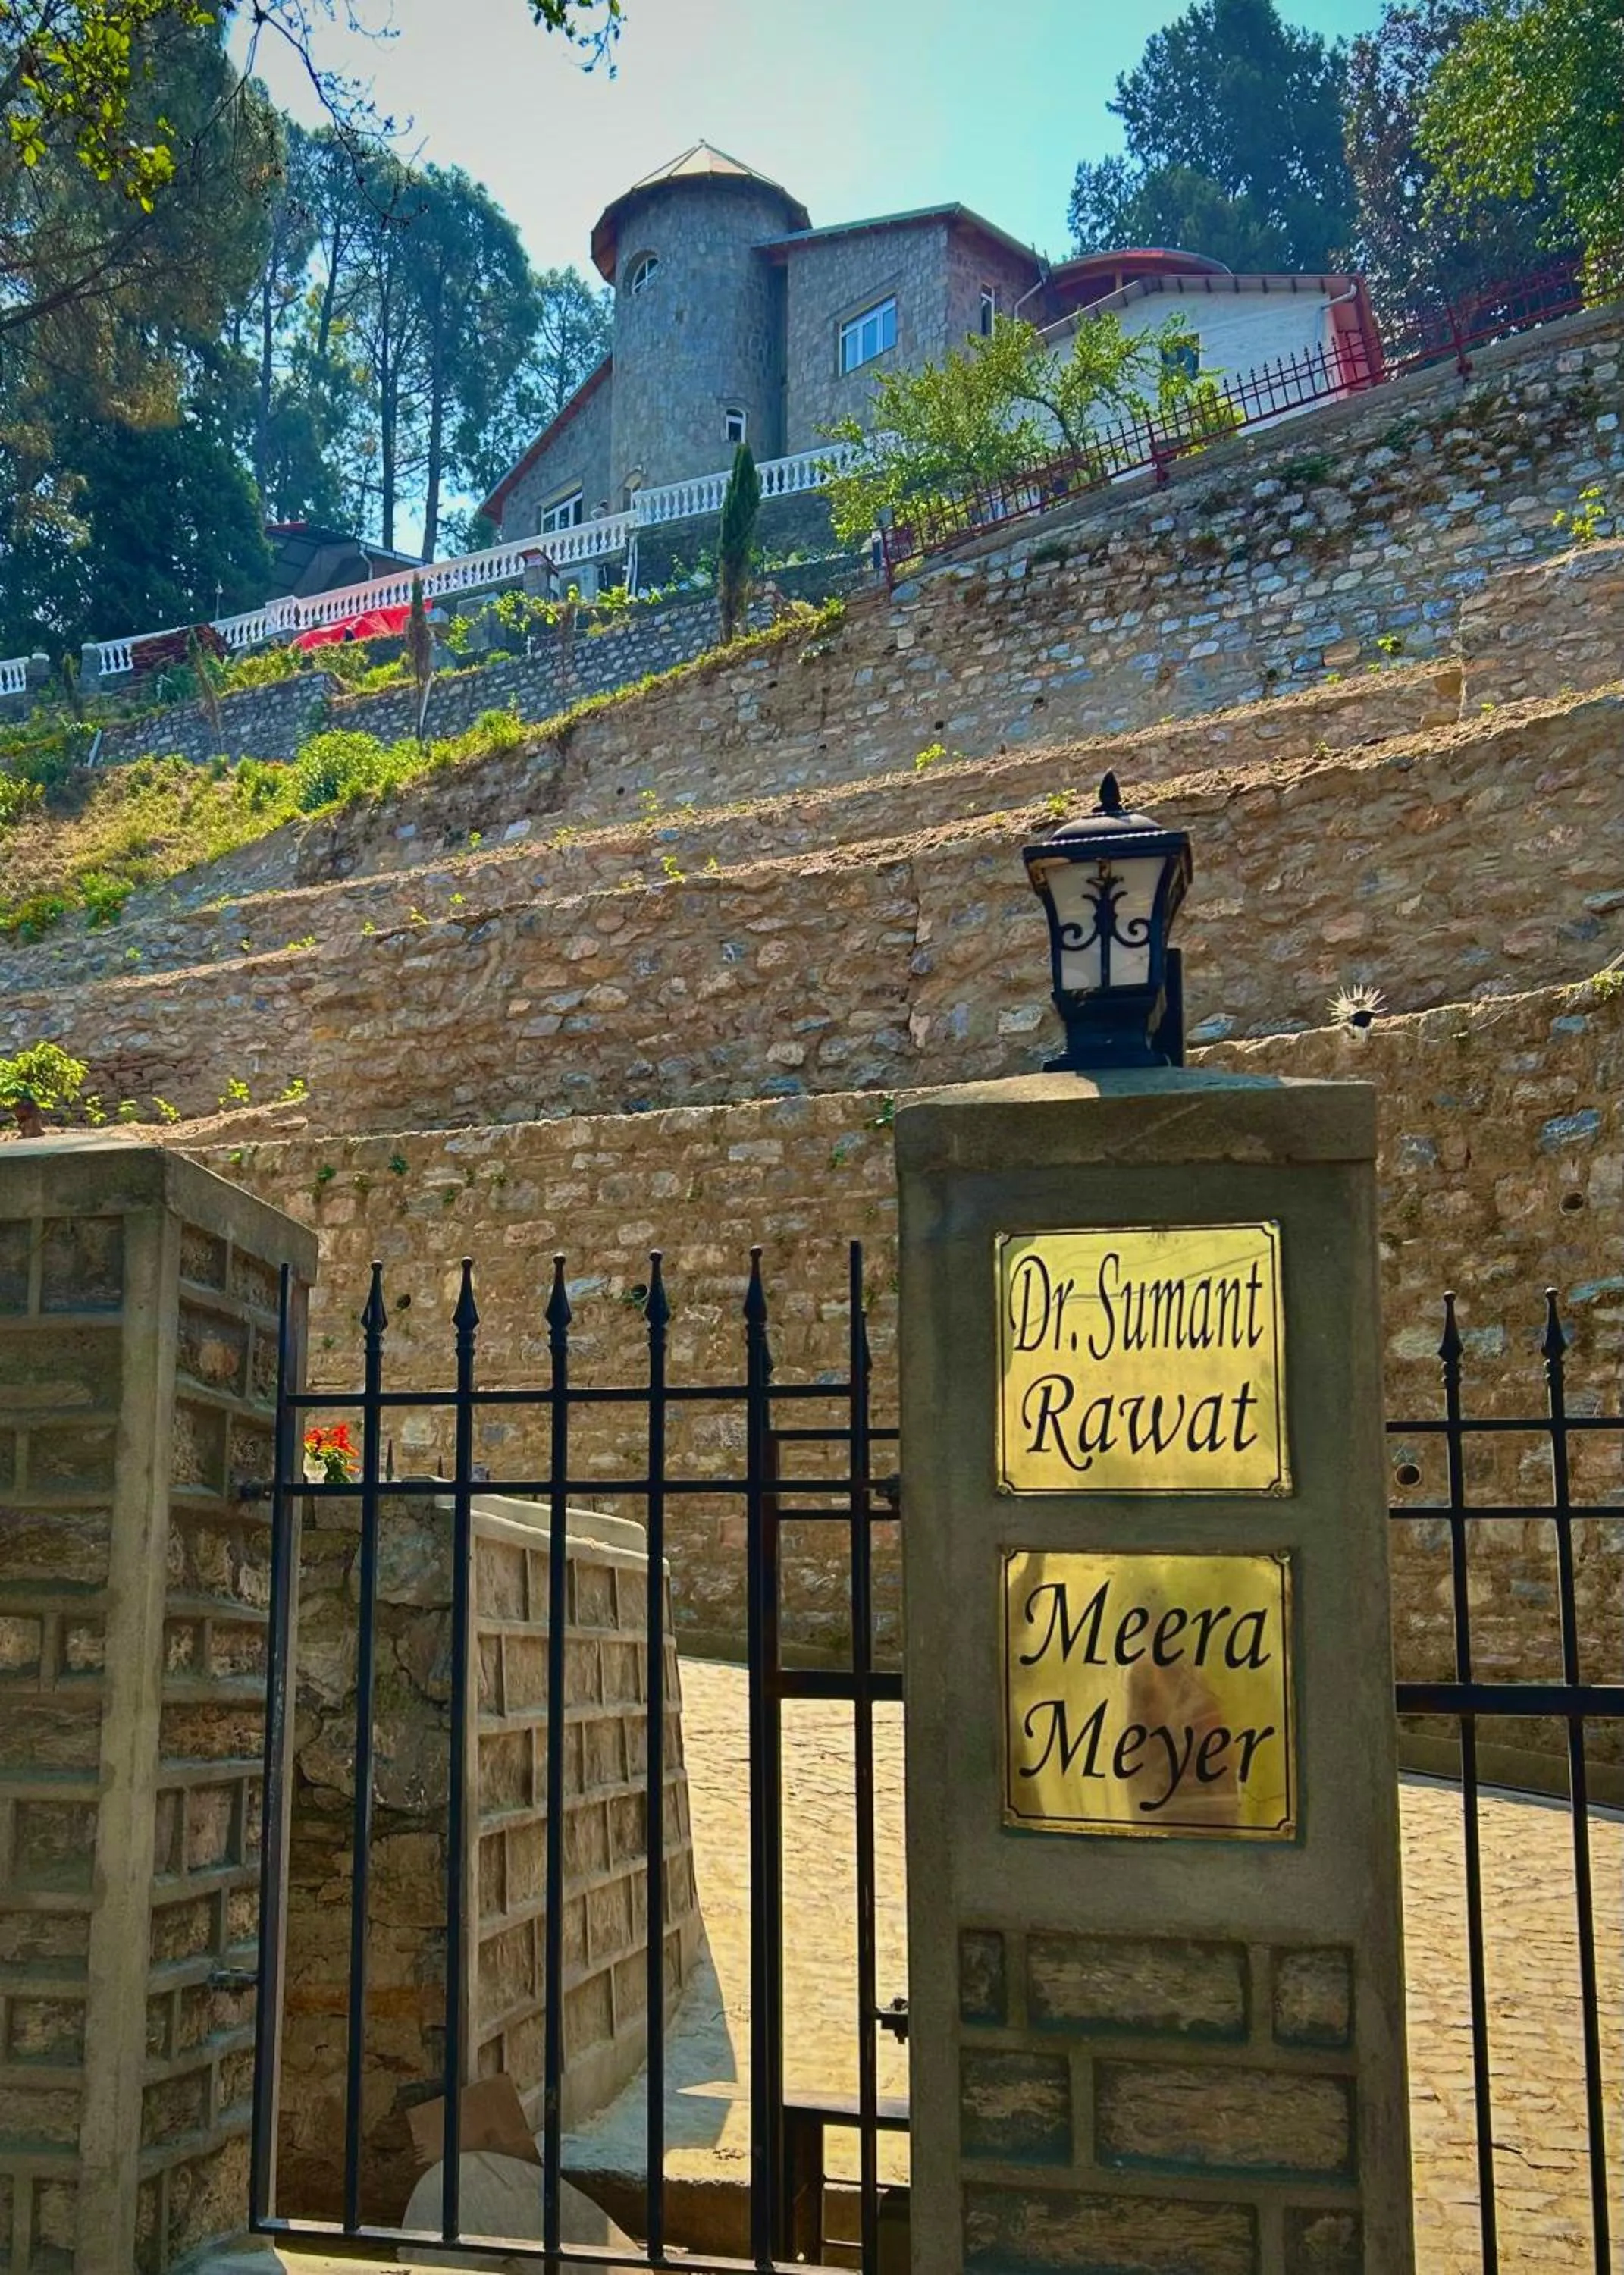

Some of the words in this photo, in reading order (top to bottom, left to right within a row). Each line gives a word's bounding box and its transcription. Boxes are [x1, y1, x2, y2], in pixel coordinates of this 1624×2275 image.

[1009, 1255, 1077, 1351] Dr.
[1088, 1253, 1264, 1361] Sumant
[1022, 1373, 1259, 1471] Rawat
[1019, 1579, 1271, 1669] Meera
[1019, 1698, 1275, 1812] Meyer
